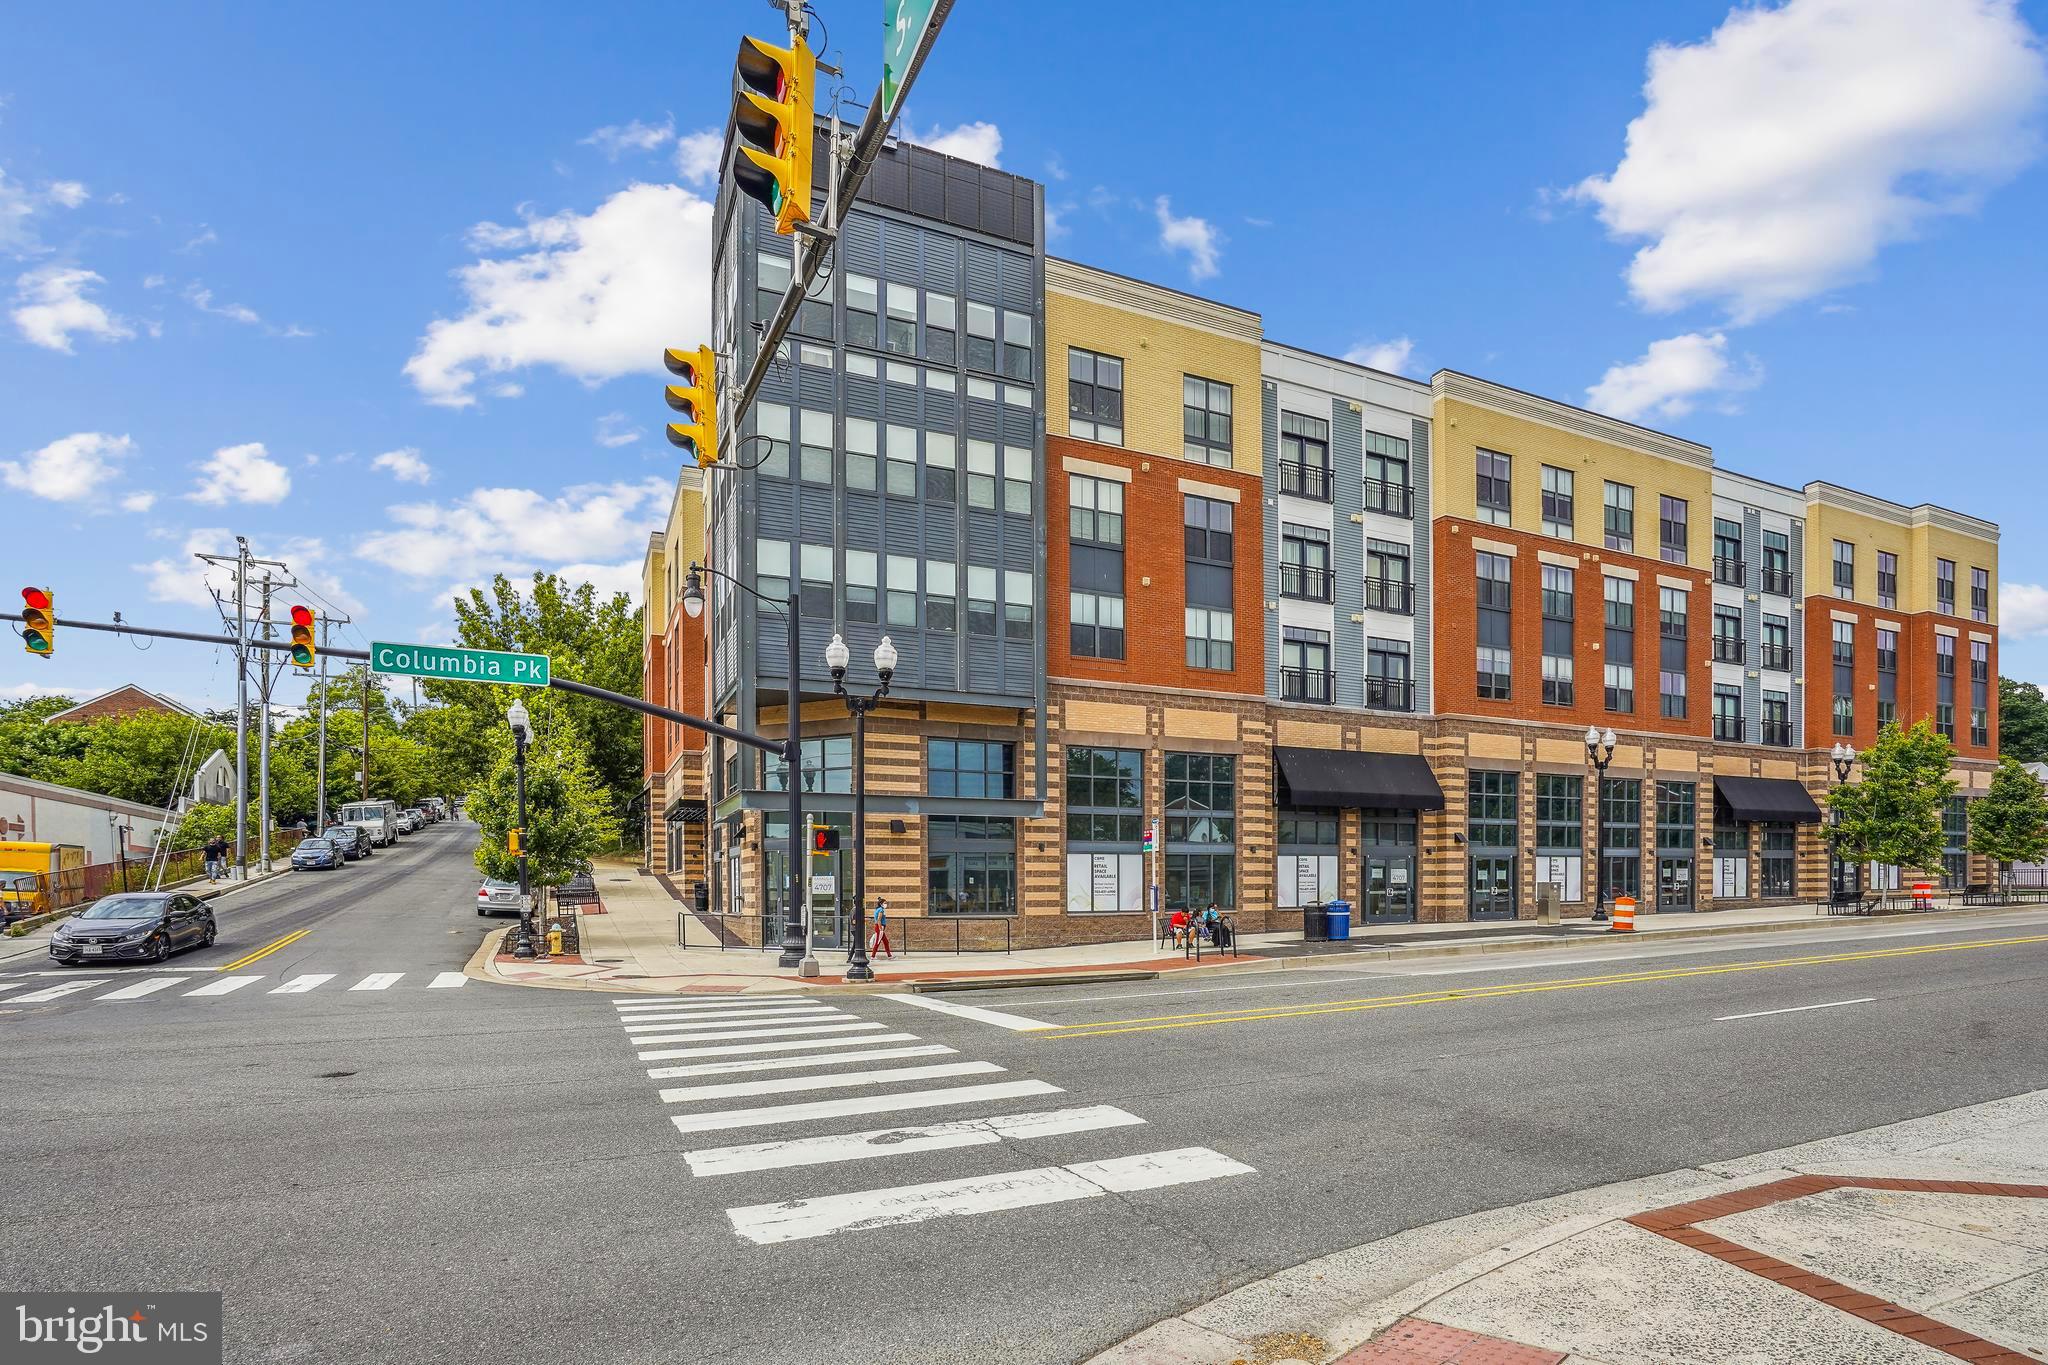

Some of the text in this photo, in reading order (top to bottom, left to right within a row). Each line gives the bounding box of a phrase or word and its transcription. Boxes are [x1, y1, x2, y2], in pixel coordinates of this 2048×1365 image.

[378, 648, 542, 679] Columbia Pk
[814, 883, 832, 891] 4707
